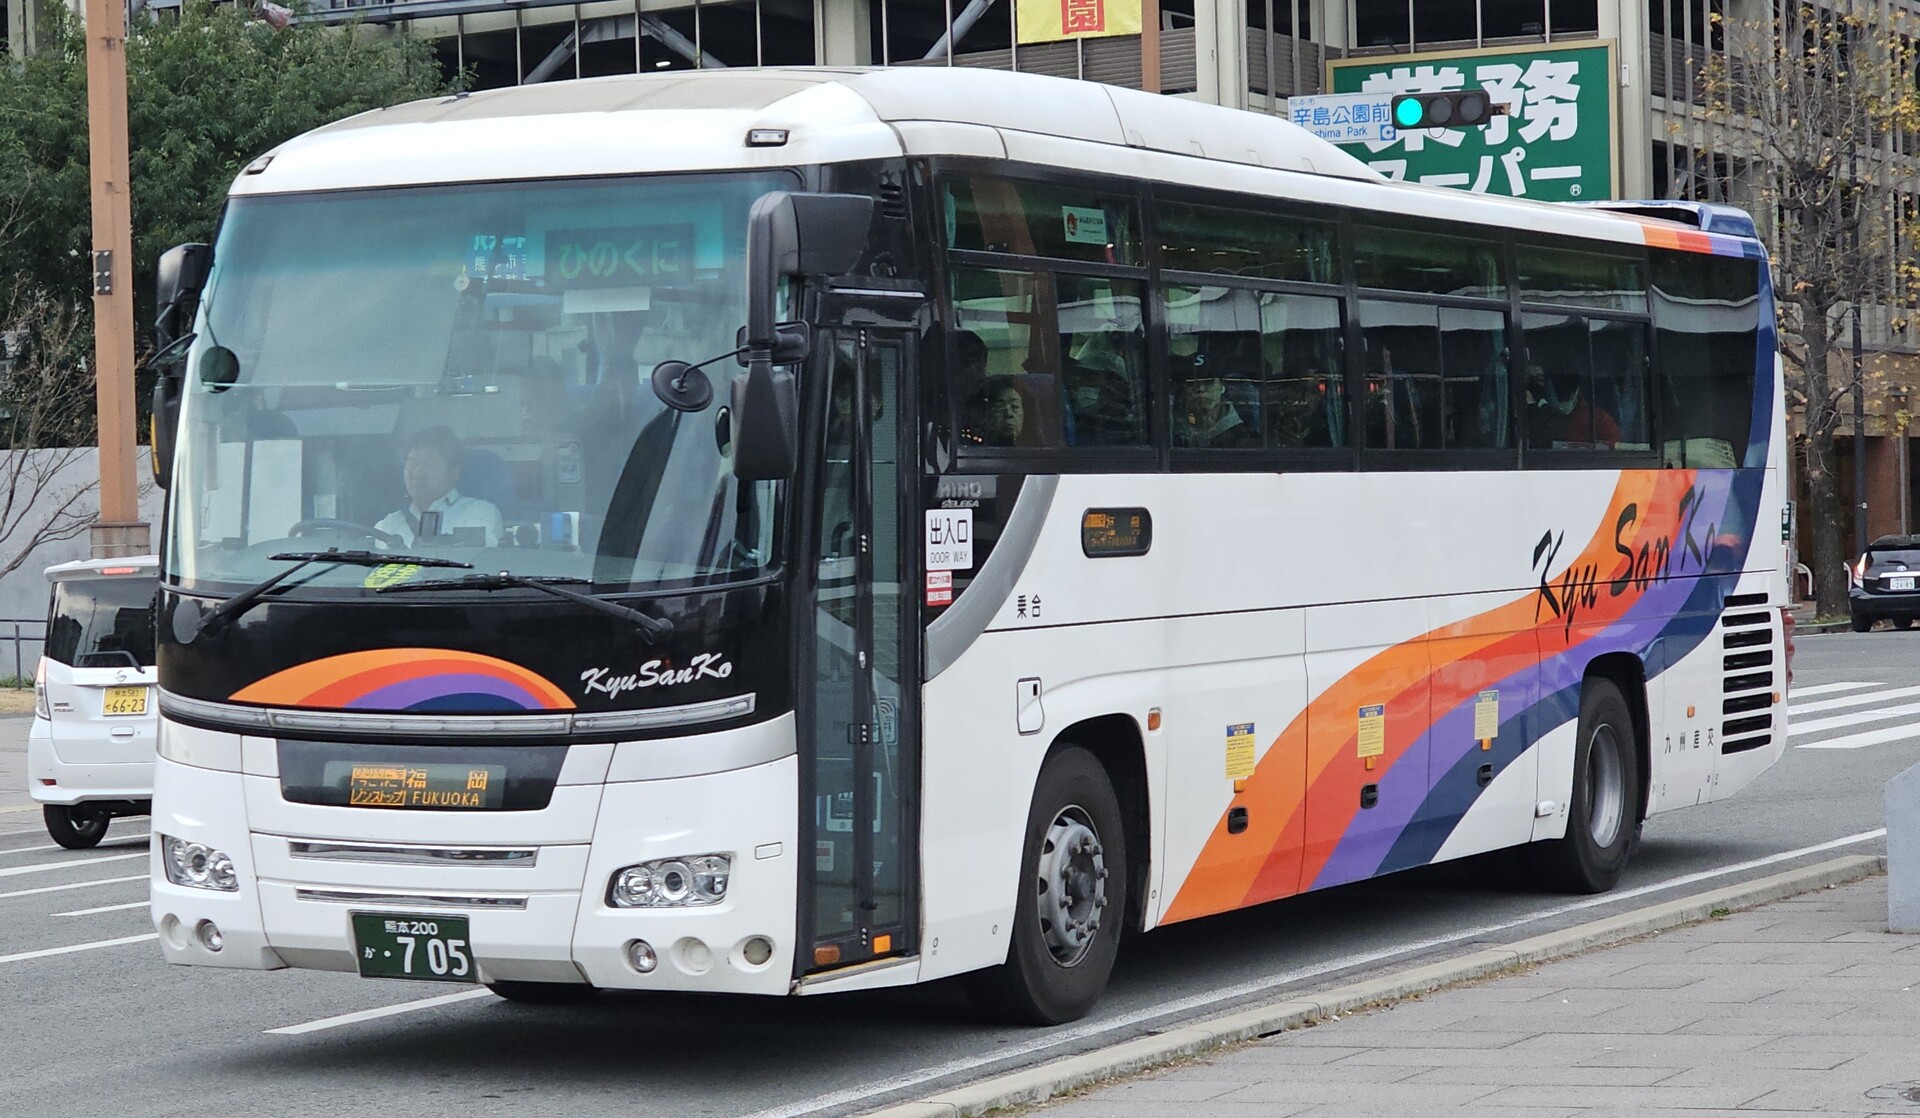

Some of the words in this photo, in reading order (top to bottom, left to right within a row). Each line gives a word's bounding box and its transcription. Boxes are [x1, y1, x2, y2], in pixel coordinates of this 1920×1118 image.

[1293, 102, 1391, 127] 辛島公園前
[1361, 60, 1582, 153] 業務
[1311, 128, 1341, 139] shima
[1347, 126, 1368, 137] Park
[559, 239, 681, 280] ひのくに
[937, 481, 982, 499] HINO
[929, 517, 969, 545] 出入口
[930, 551, 950, 564] DOOR
[953, 550, 969, 563] WAY
[1532, 528, 1598, 645] Kyu
[1609, 502, 1671, 598] San
[1678, 484, 1716, 572] Ko
[1016, 593, 1042, 619] 乗合
[580, 652, 733, 700] KyuSanKo
[112, 698, 146, 713] 66-23
[412, 790, 480, 806] FUKUOKA
[384, 920, 438, 935] 熊本200
